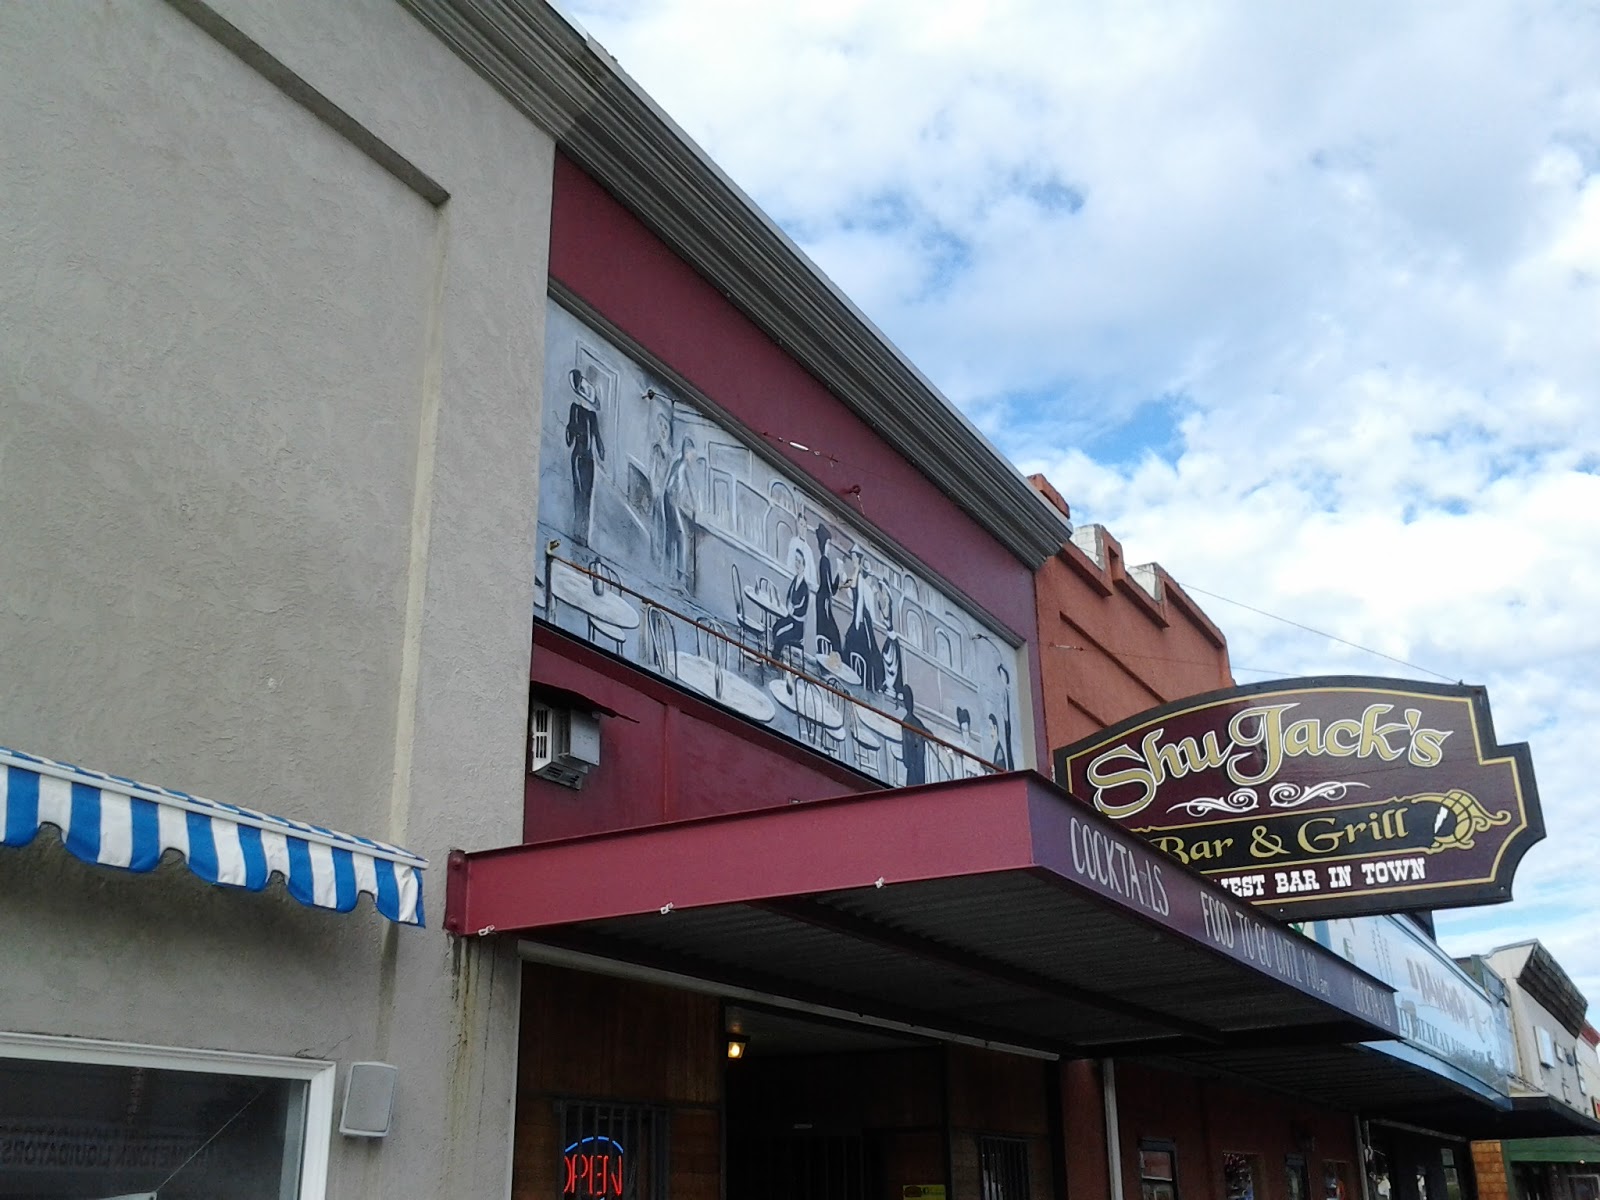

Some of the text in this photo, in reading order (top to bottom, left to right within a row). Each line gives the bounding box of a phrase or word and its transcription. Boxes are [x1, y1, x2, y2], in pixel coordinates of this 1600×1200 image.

[1149, 807, 1410, 865] Bar & Grill
[1274, 869, 1321, 894] BAR
[1328, 865, 1352, 889] IN
[1361, 857, 1426, 886] TOWN
[1200, 890, 1235, 950] FOOD
[1235, 910, 1255, 961] TO
